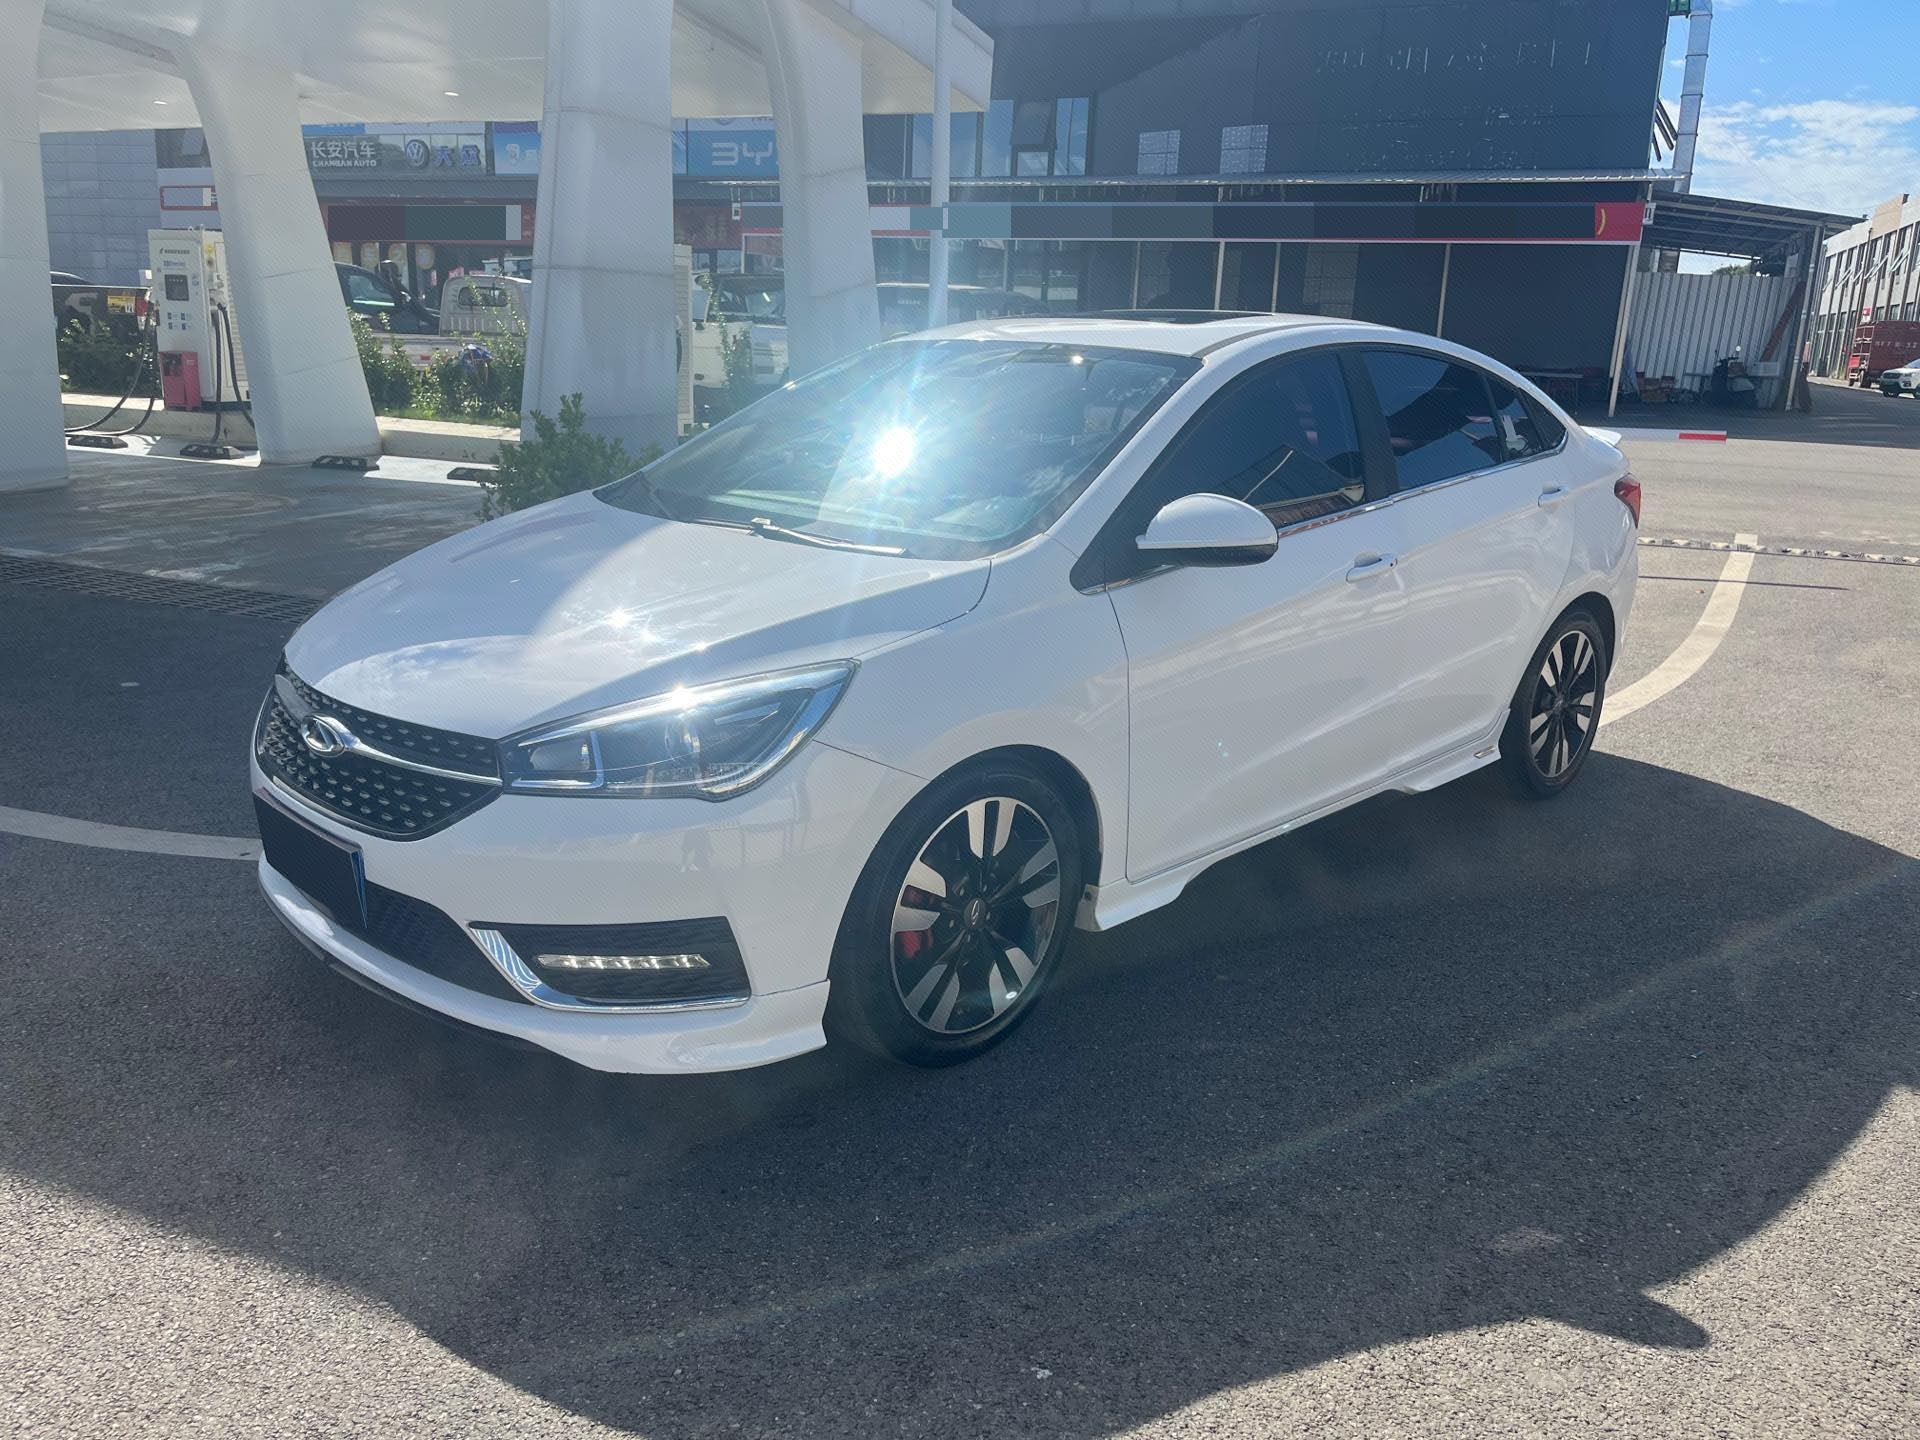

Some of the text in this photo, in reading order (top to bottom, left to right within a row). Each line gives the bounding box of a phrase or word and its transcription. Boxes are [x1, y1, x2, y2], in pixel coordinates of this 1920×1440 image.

[311, 141, 376, 160] 长安汽车
[433, 144, 480, 167] 大众
[711, 142, 779, 166] BY
